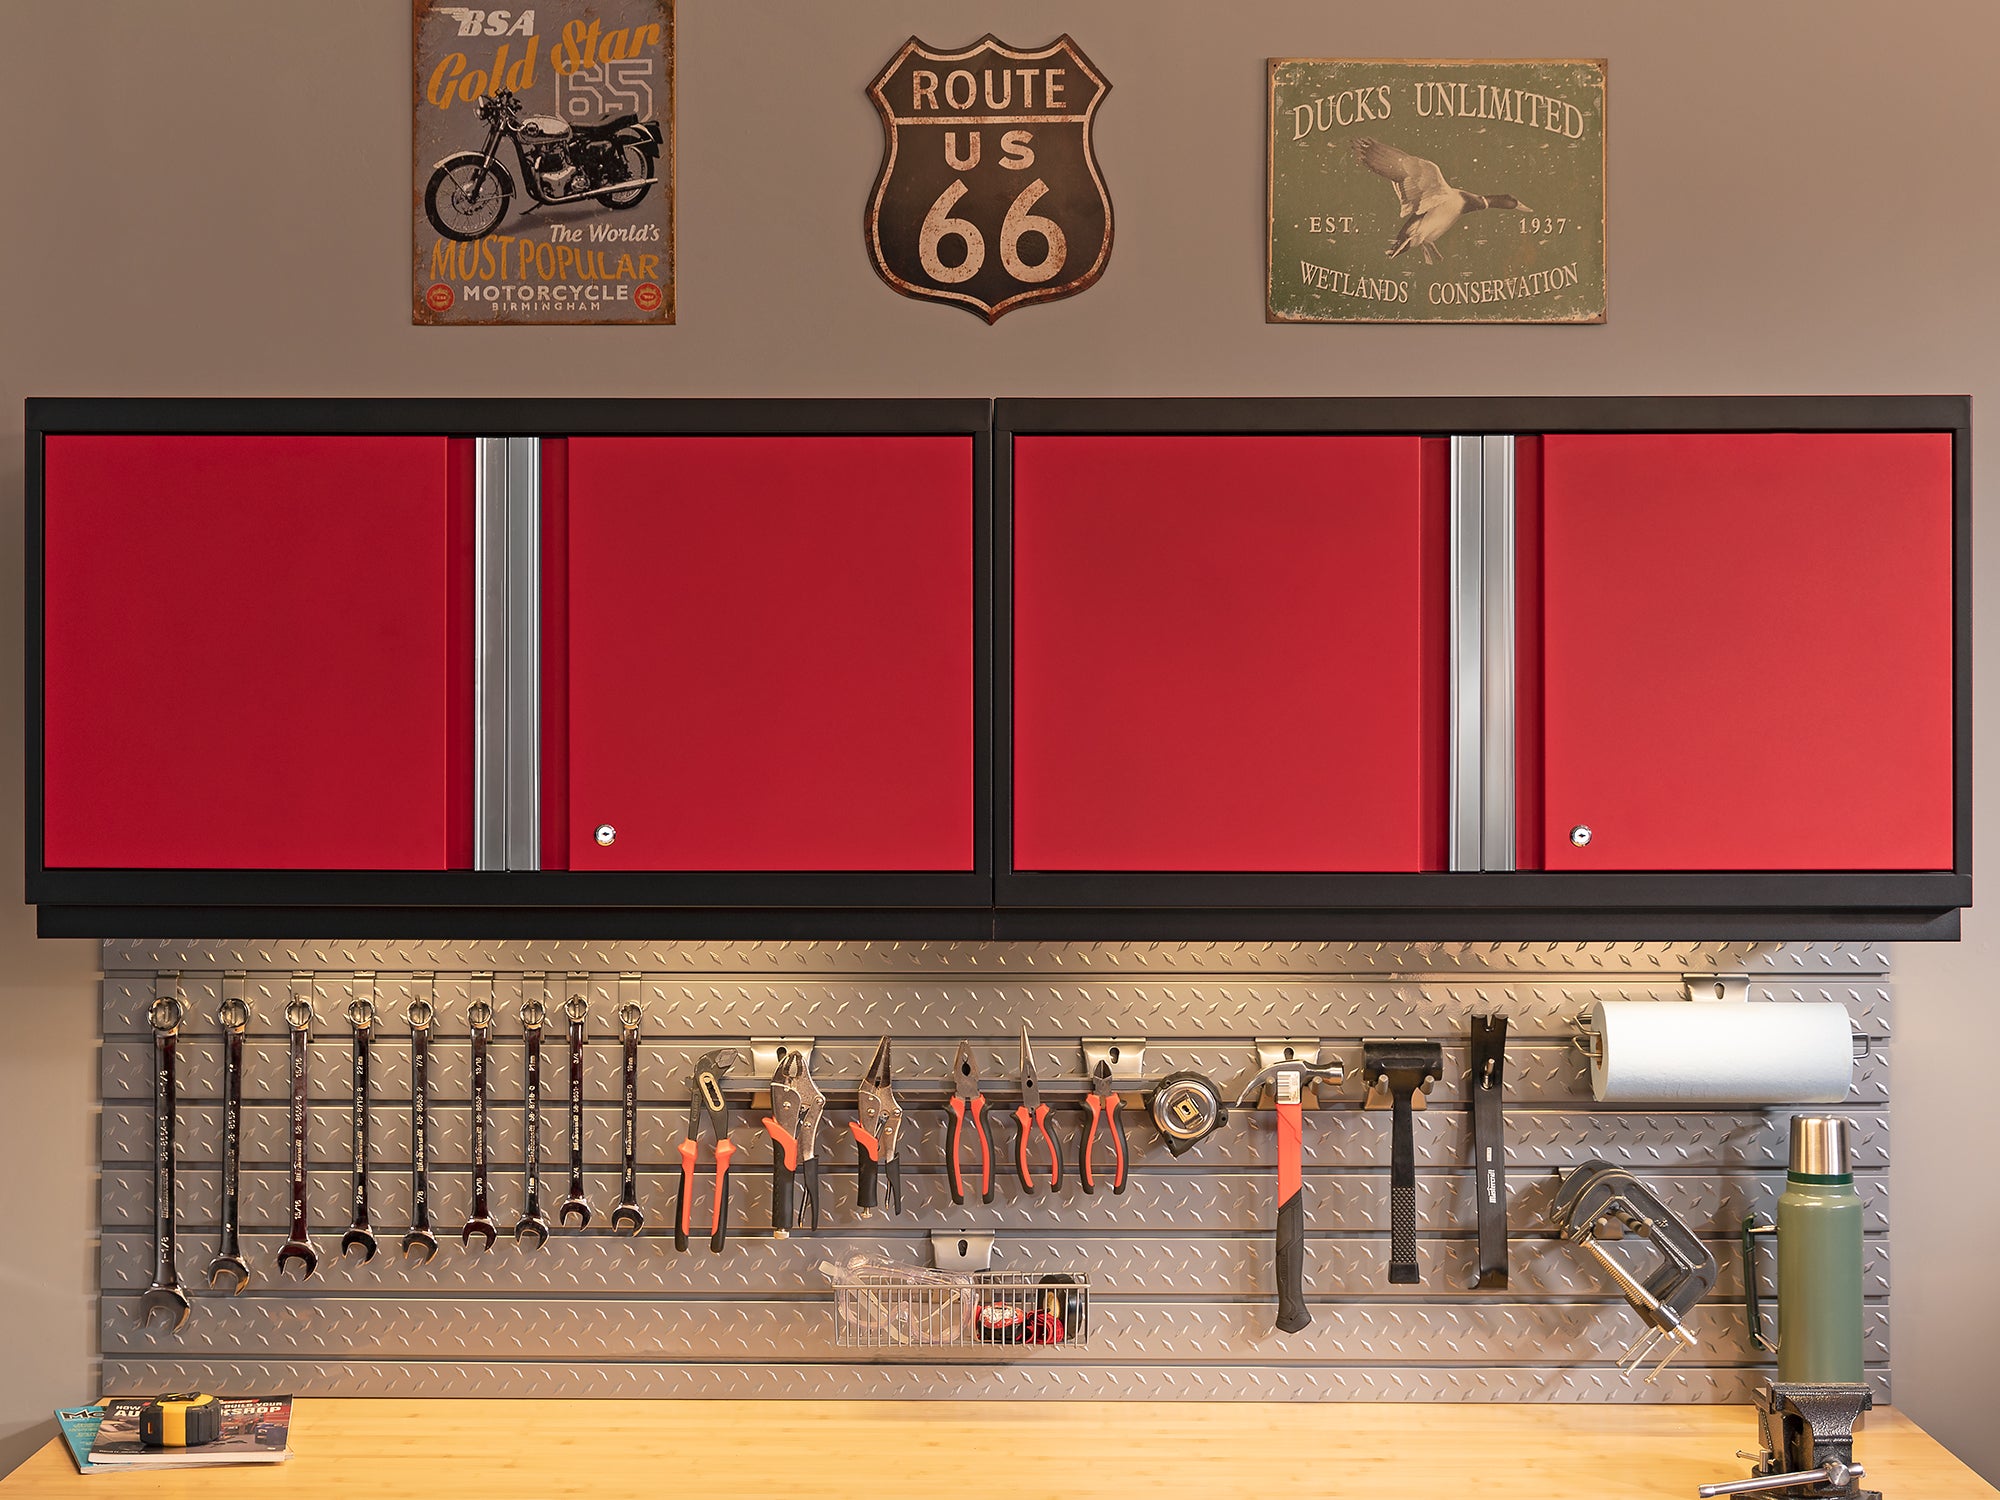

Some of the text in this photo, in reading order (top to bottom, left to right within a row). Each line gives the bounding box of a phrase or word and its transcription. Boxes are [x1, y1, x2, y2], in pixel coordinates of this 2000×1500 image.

[457, 9, 535, 37] BSA
[427, 18, 660, 110] Gold Star
[556, 59, 652, 124] 65
[912, 68, 1067, 110] ROUTE
[1292, 82, 1584, 141] DUCKS UNLIMITED
[550, 223, 660, 243] The World's
[918, 178, 1067, 283] 66
[1309, 216, 1360, 234] EST.
[1518, 218, 1568, 235] 1937
[518, 238, 660, 281] POPULAR
[463, 285, 629, 301] MOTORCYCLE
[1300, 260, 1580, 305] WETLANDS CONSERVATION
[492, 302, 601, 312] BIRMINGHAM
[221, 1406, 282, 1416] KSHOP
